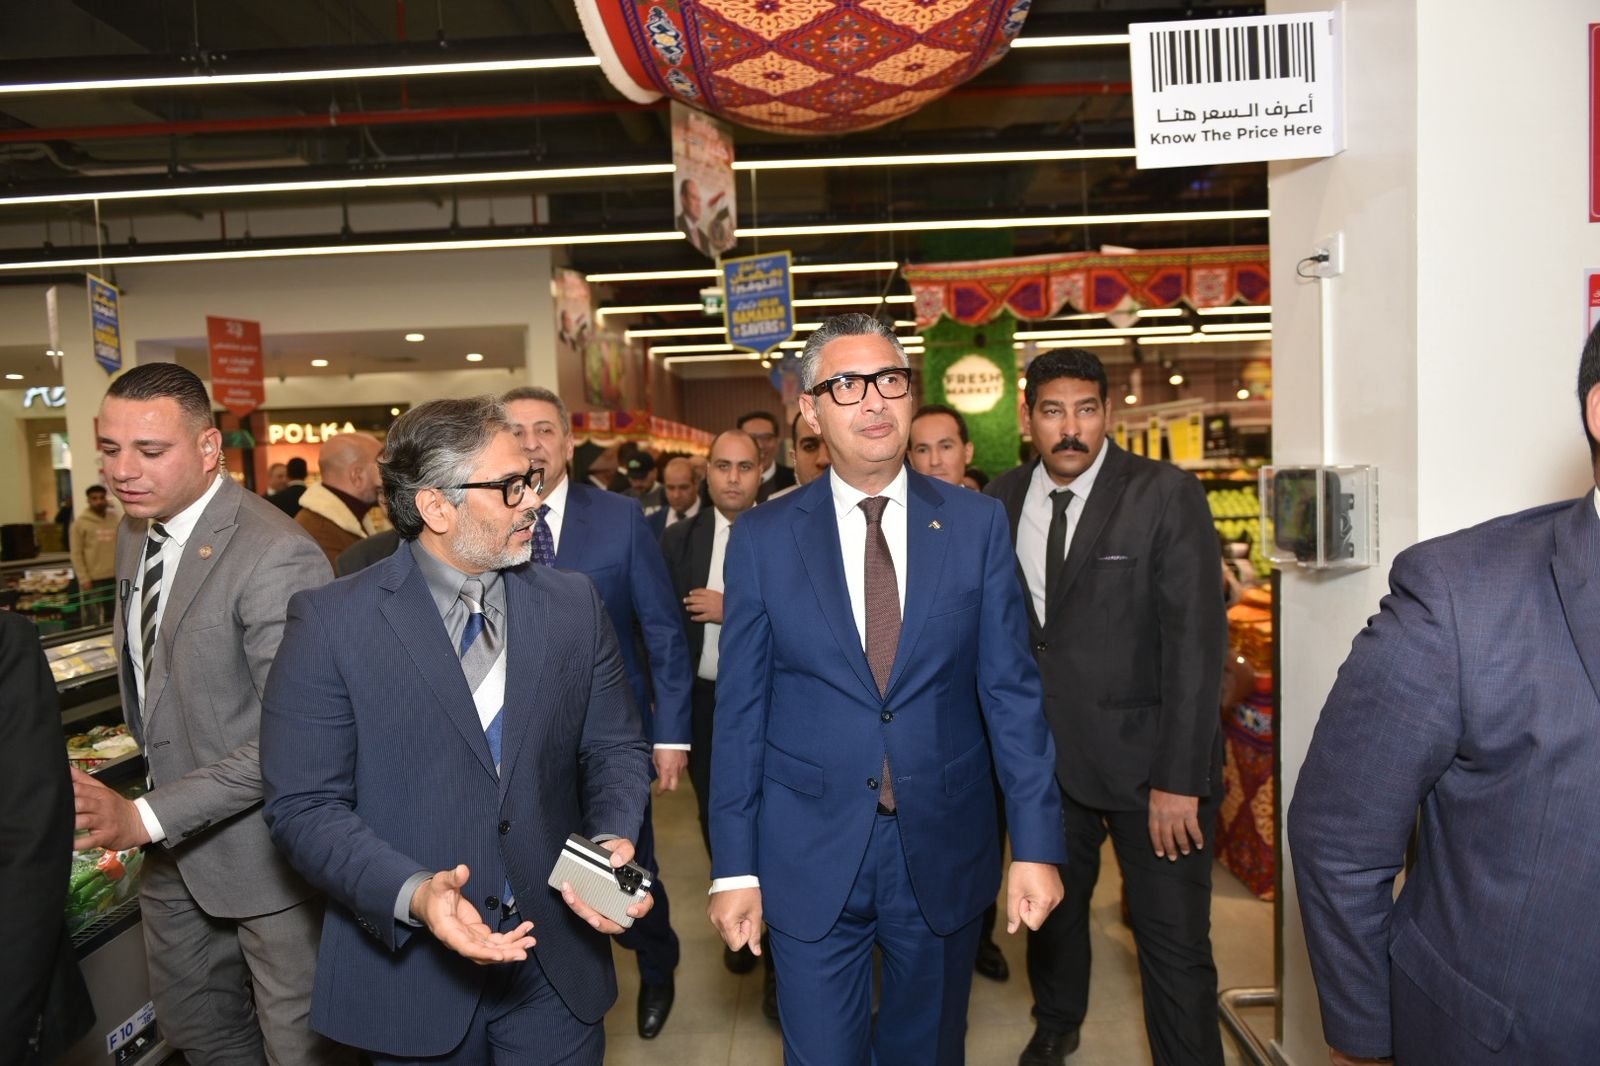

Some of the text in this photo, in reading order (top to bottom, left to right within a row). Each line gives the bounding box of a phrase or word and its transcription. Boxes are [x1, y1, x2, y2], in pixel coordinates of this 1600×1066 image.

[1157, 93, 1313, 124] أعرف السعر هنا
[1150, 124, 1323, 145] Know The Price Here
[732, 304, 786, 324] RAMADAN
[740, 320, 780, 337] SAVERS
[946, 373, 1000, 384] FRESH
[946, 386, 999, 395] MARKET
[110, 1022, 133, 1050] F 10
